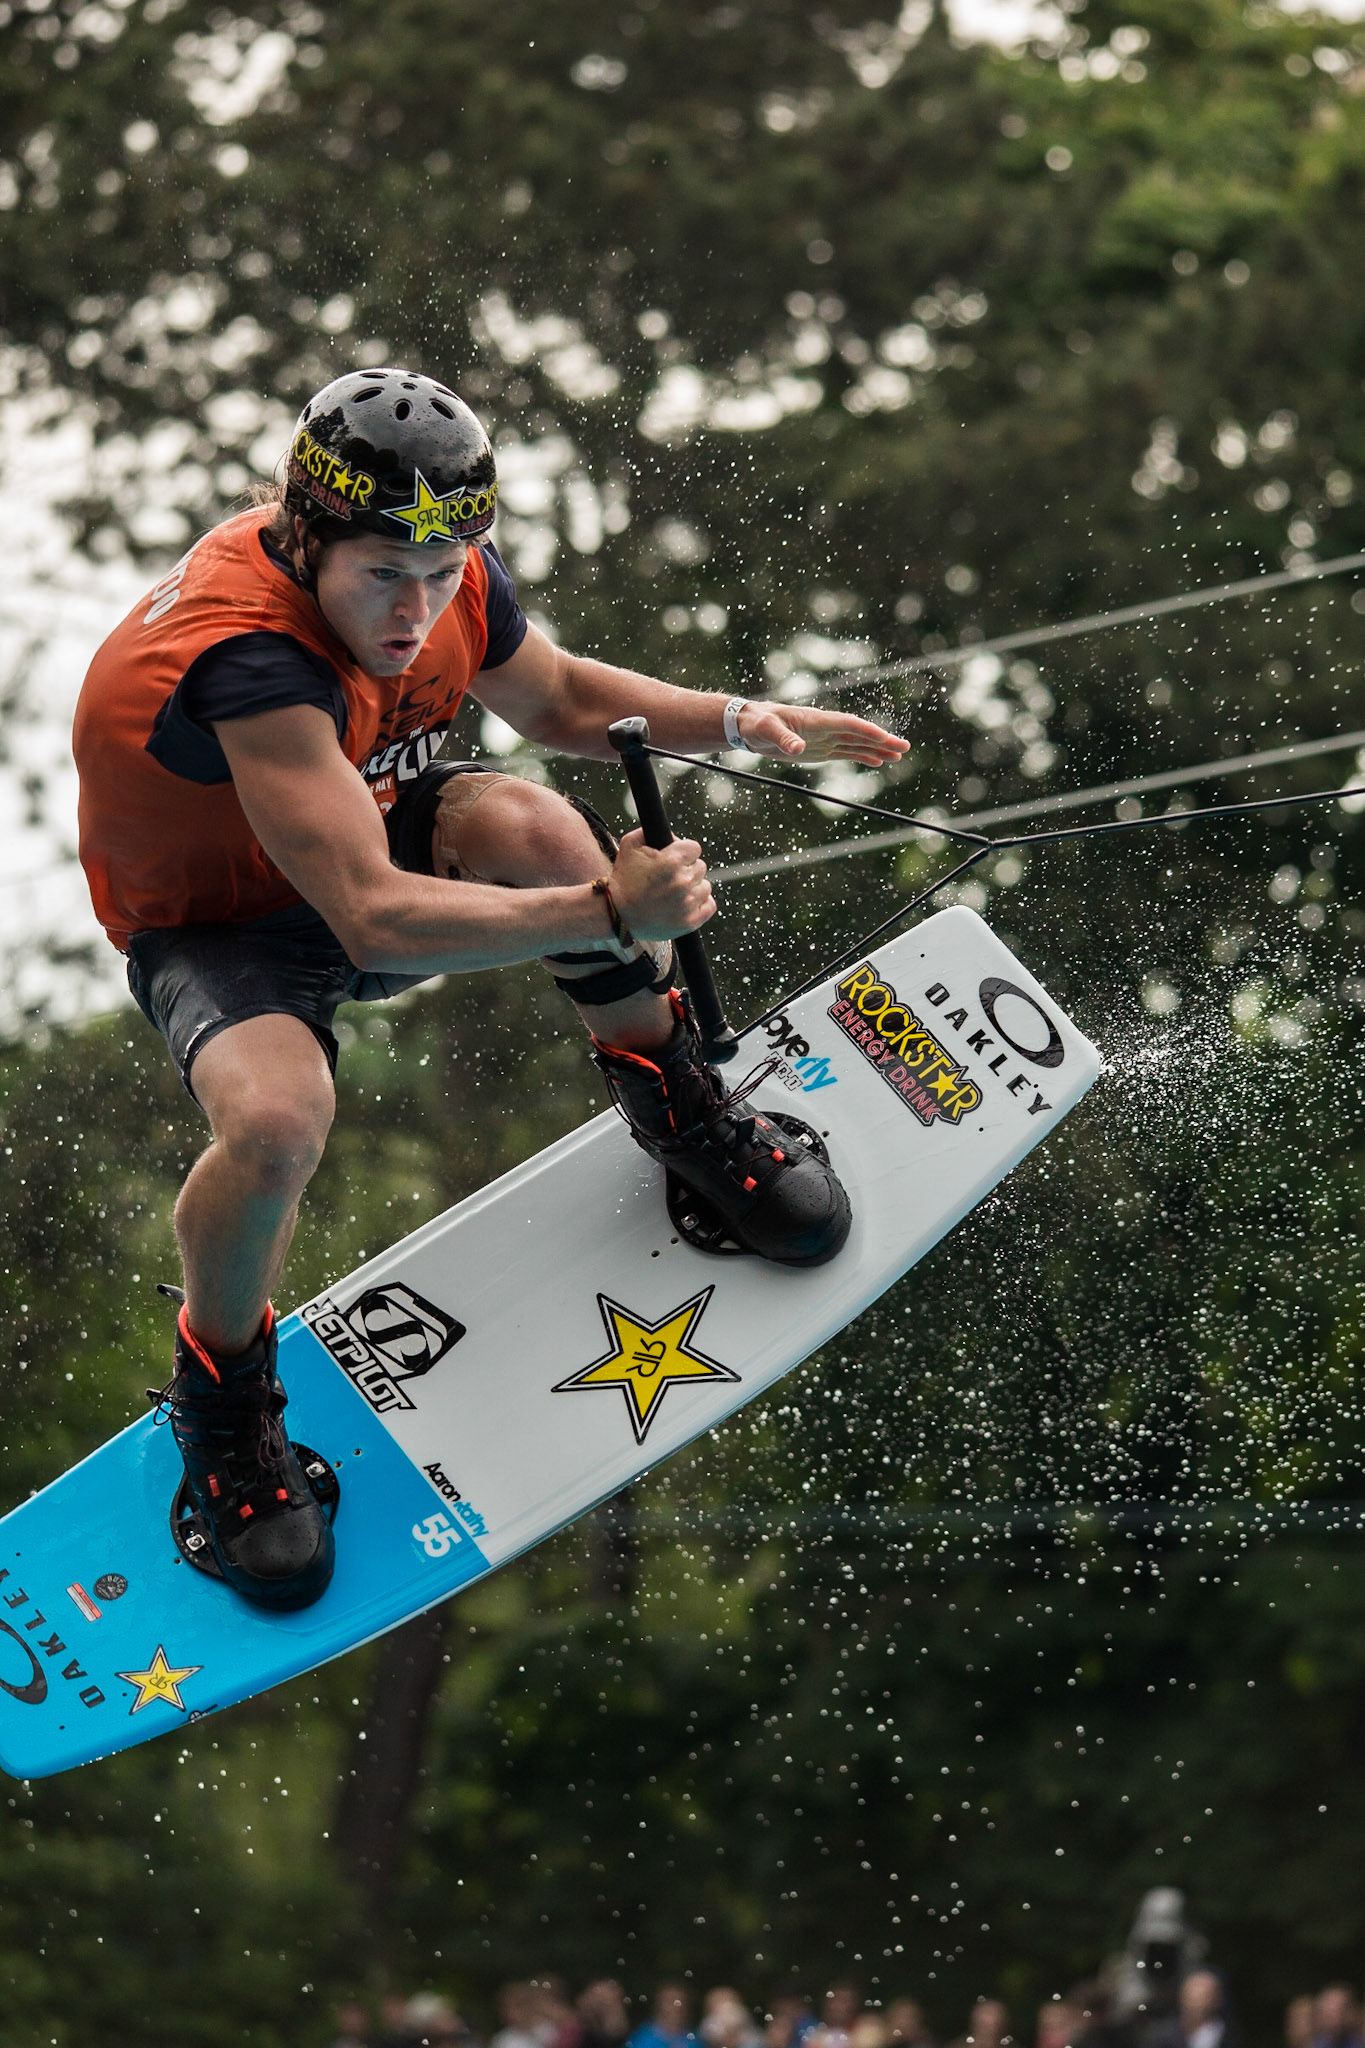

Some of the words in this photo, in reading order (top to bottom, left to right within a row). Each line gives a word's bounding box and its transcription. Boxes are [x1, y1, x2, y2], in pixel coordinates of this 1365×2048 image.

[375, 777, 392, 793] MAY
[832, 999, 895, 1066] ENERGY
[888, 1064, 941, 1121] DRINK
[840, 965, 979, 1119] ROCKSTAR
[925, 982, 1053, 1116] OAKLEY
[302, 1298, 417, 1414] JETPILOT
[412, 1512, 463, 1558] 55
